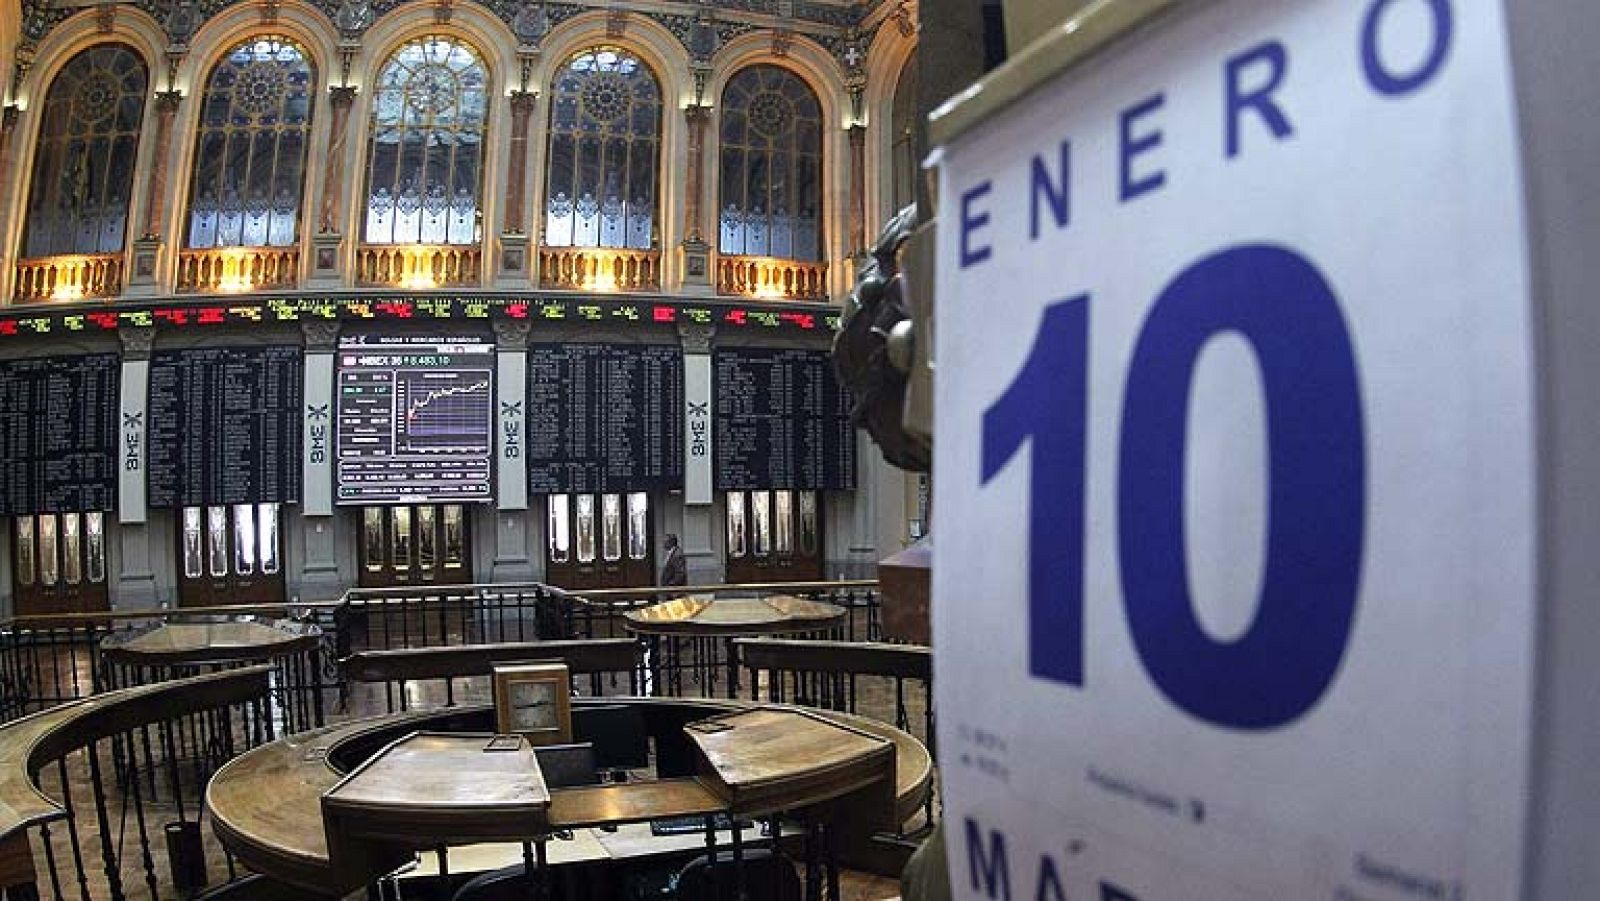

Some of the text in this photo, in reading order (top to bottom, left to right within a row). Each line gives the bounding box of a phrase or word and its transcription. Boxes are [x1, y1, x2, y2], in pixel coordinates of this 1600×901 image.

[959, 0, 1454, 269] ENERO
[126, 432, 140, 472] BME
[309, 424, 325, 464] BME
[504, 420, 520, 460] BME
[690, 420, 706, 457] BME
[979, 240, 1368, 734] 10
[964, 816, 1138, 901] MA
